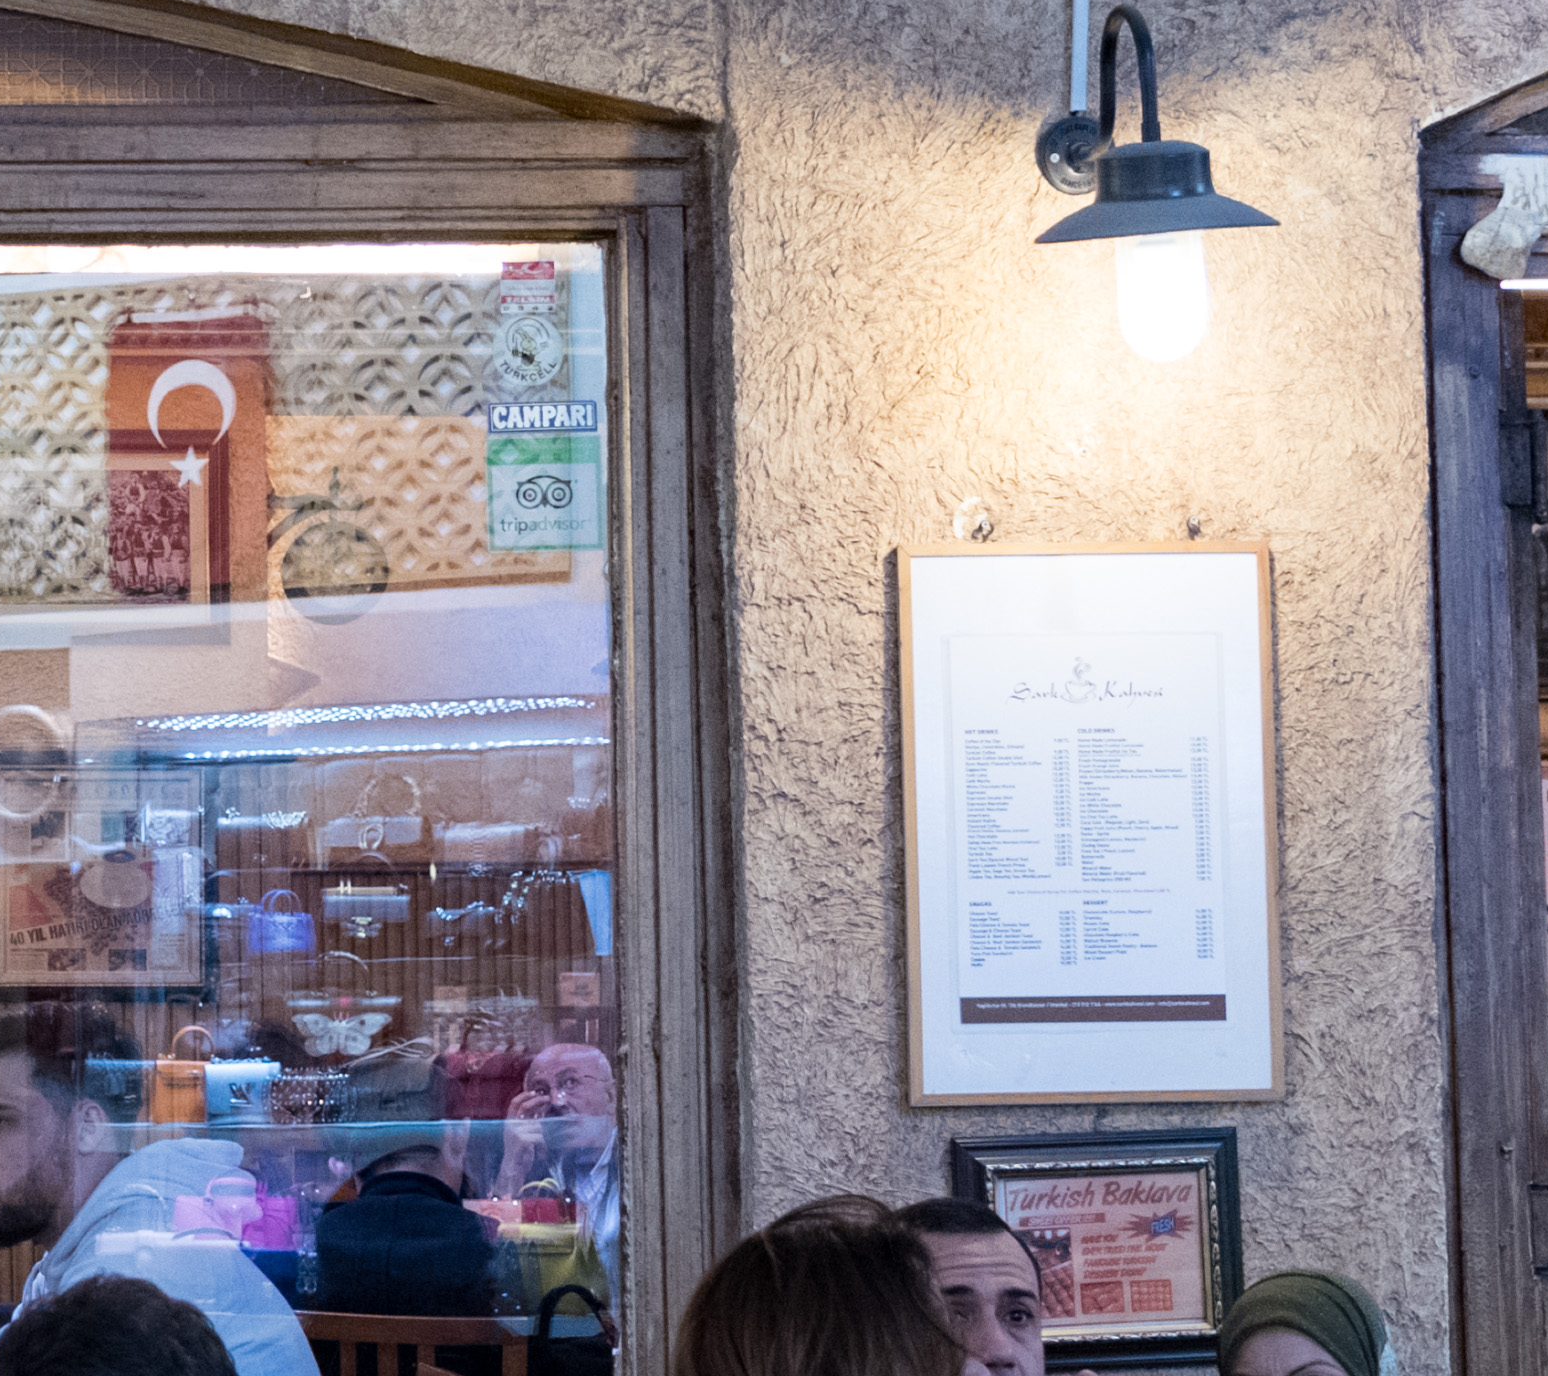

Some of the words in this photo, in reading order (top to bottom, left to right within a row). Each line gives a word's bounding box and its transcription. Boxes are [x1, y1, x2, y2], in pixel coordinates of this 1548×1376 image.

[500, 360, 558, 382] TURKCELL
[493, 404, 594, 430] CAMPARI
[500, 517, 589, 535] tripadvisor
[10, 930, 25, 946] 40
[27, 926, 48, 944] YIL
[1008, 1181, 1095, 1213] Turkish
[1101, 1179, 1192, 1206] Baklava
